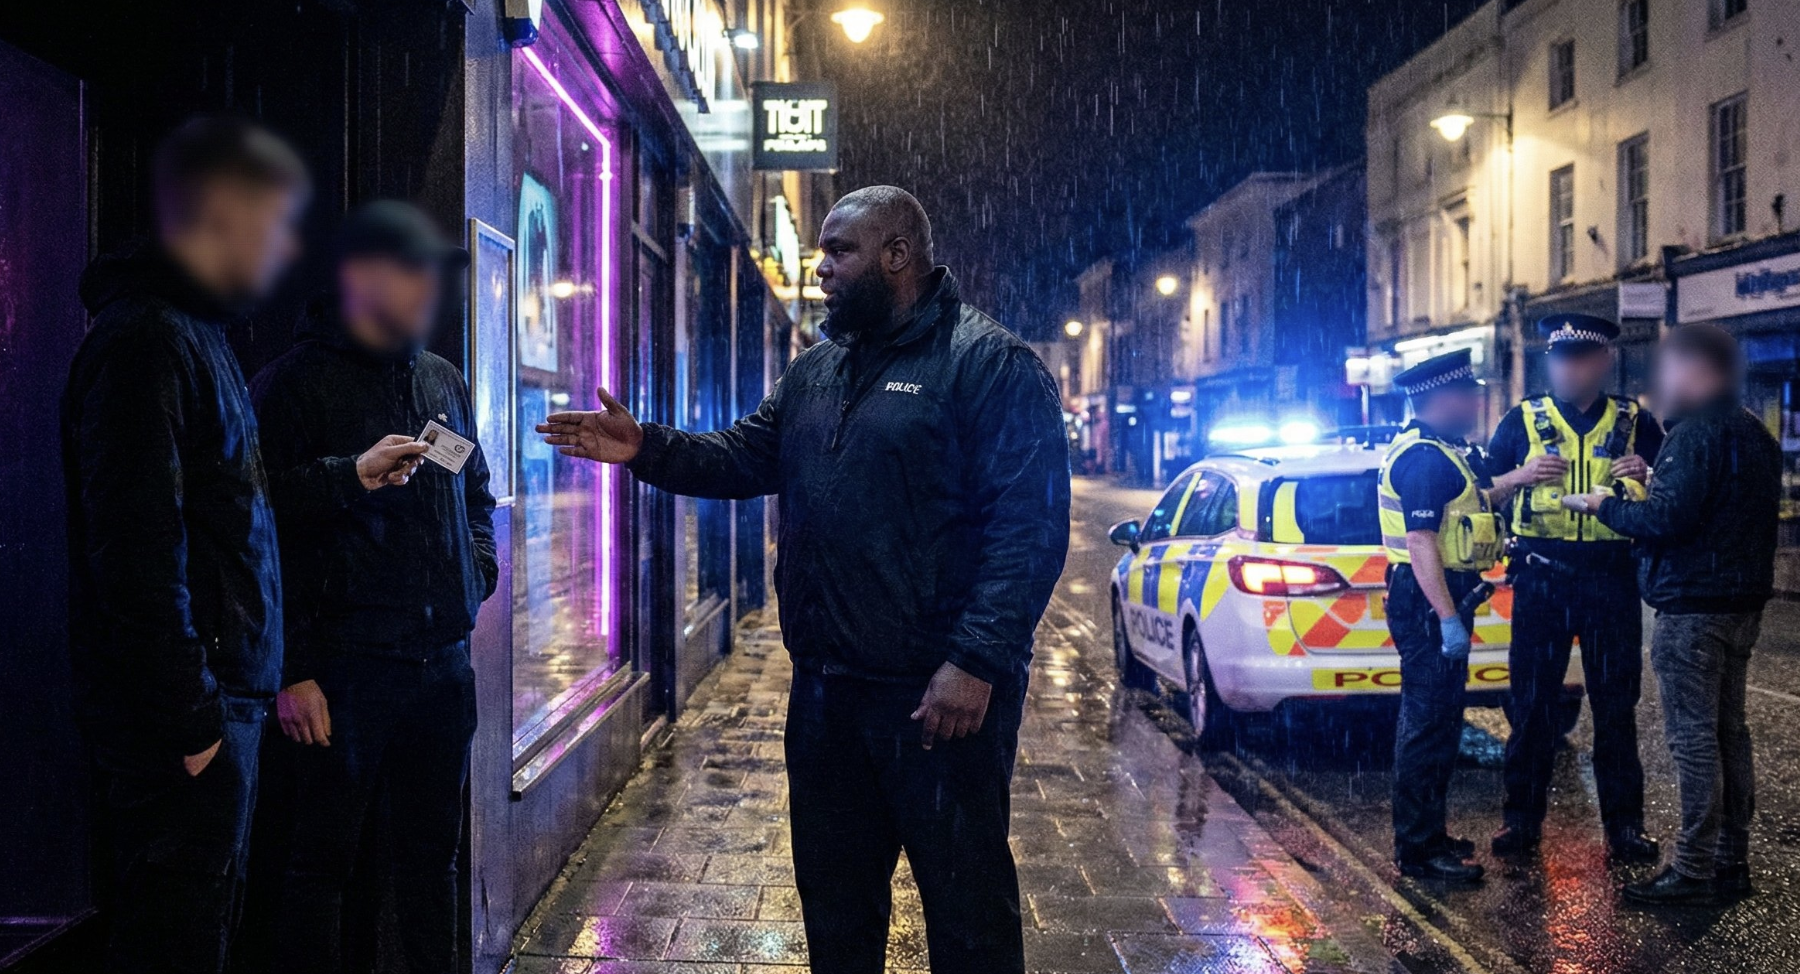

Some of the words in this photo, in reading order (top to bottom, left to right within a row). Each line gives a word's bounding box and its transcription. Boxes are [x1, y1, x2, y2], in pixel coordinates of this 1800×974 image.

[885, 381, 922, 395] POLICE
[1130, 608, 1175, 650] POLICE
[1334, 666, 1510, 688] POC
